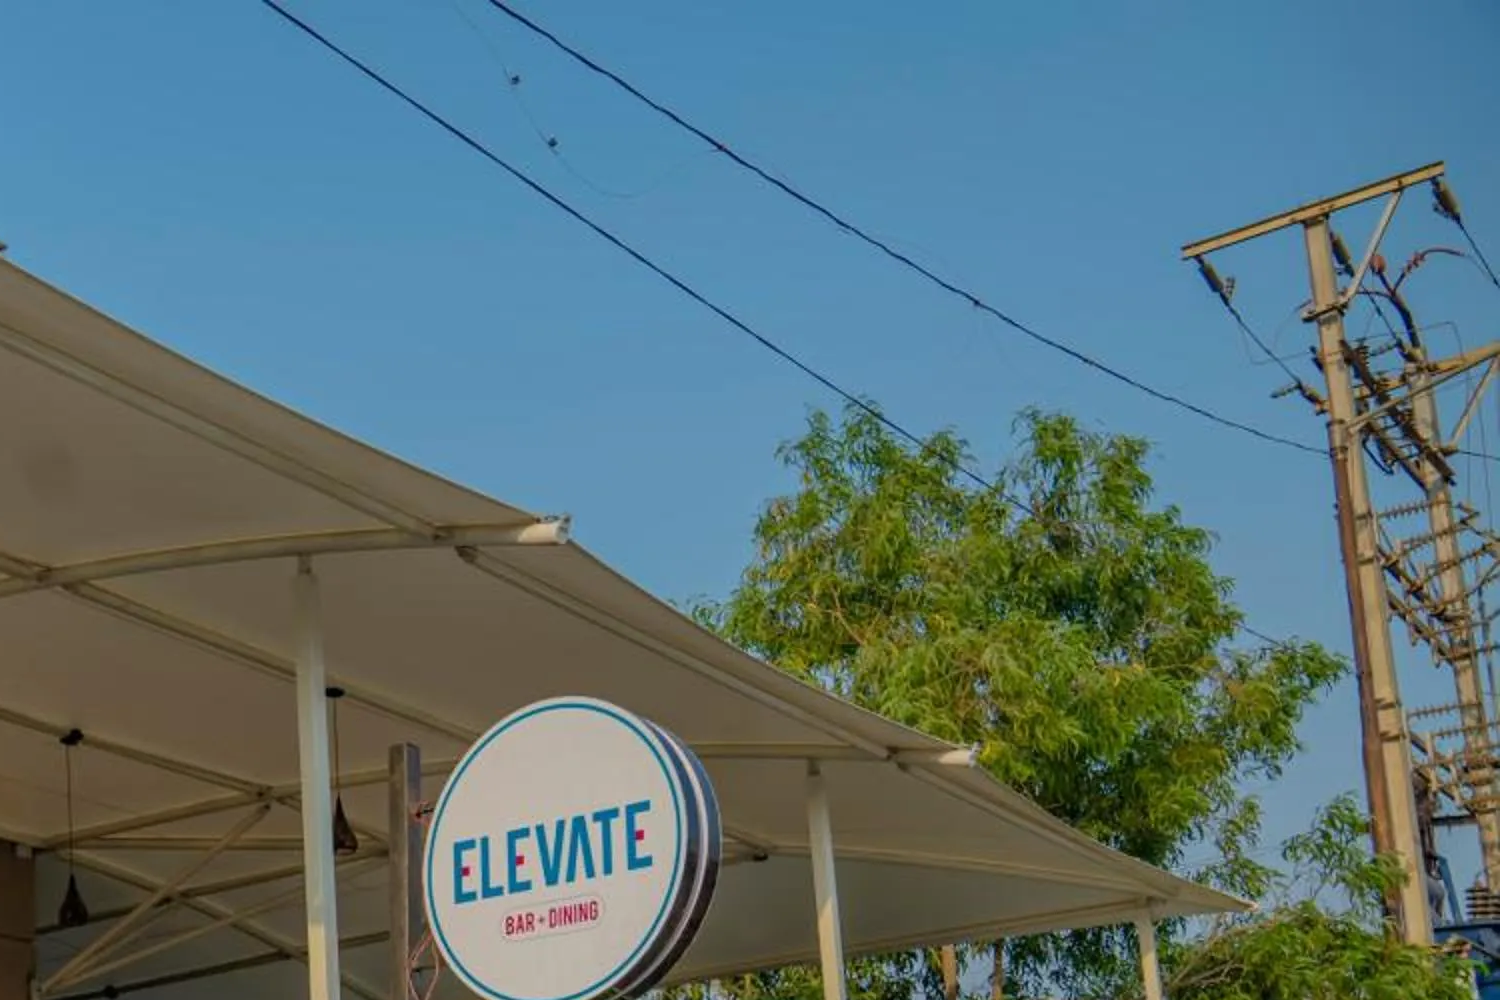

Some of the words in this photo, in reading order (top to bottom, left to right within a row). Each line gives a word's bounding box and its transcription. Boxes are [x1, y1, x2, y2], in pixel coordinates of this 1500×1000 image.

[453, 801, 653, 904] ELEVATE
[505, 912, 535, 936] BAR
[548, 900, 598, 929] DINING
